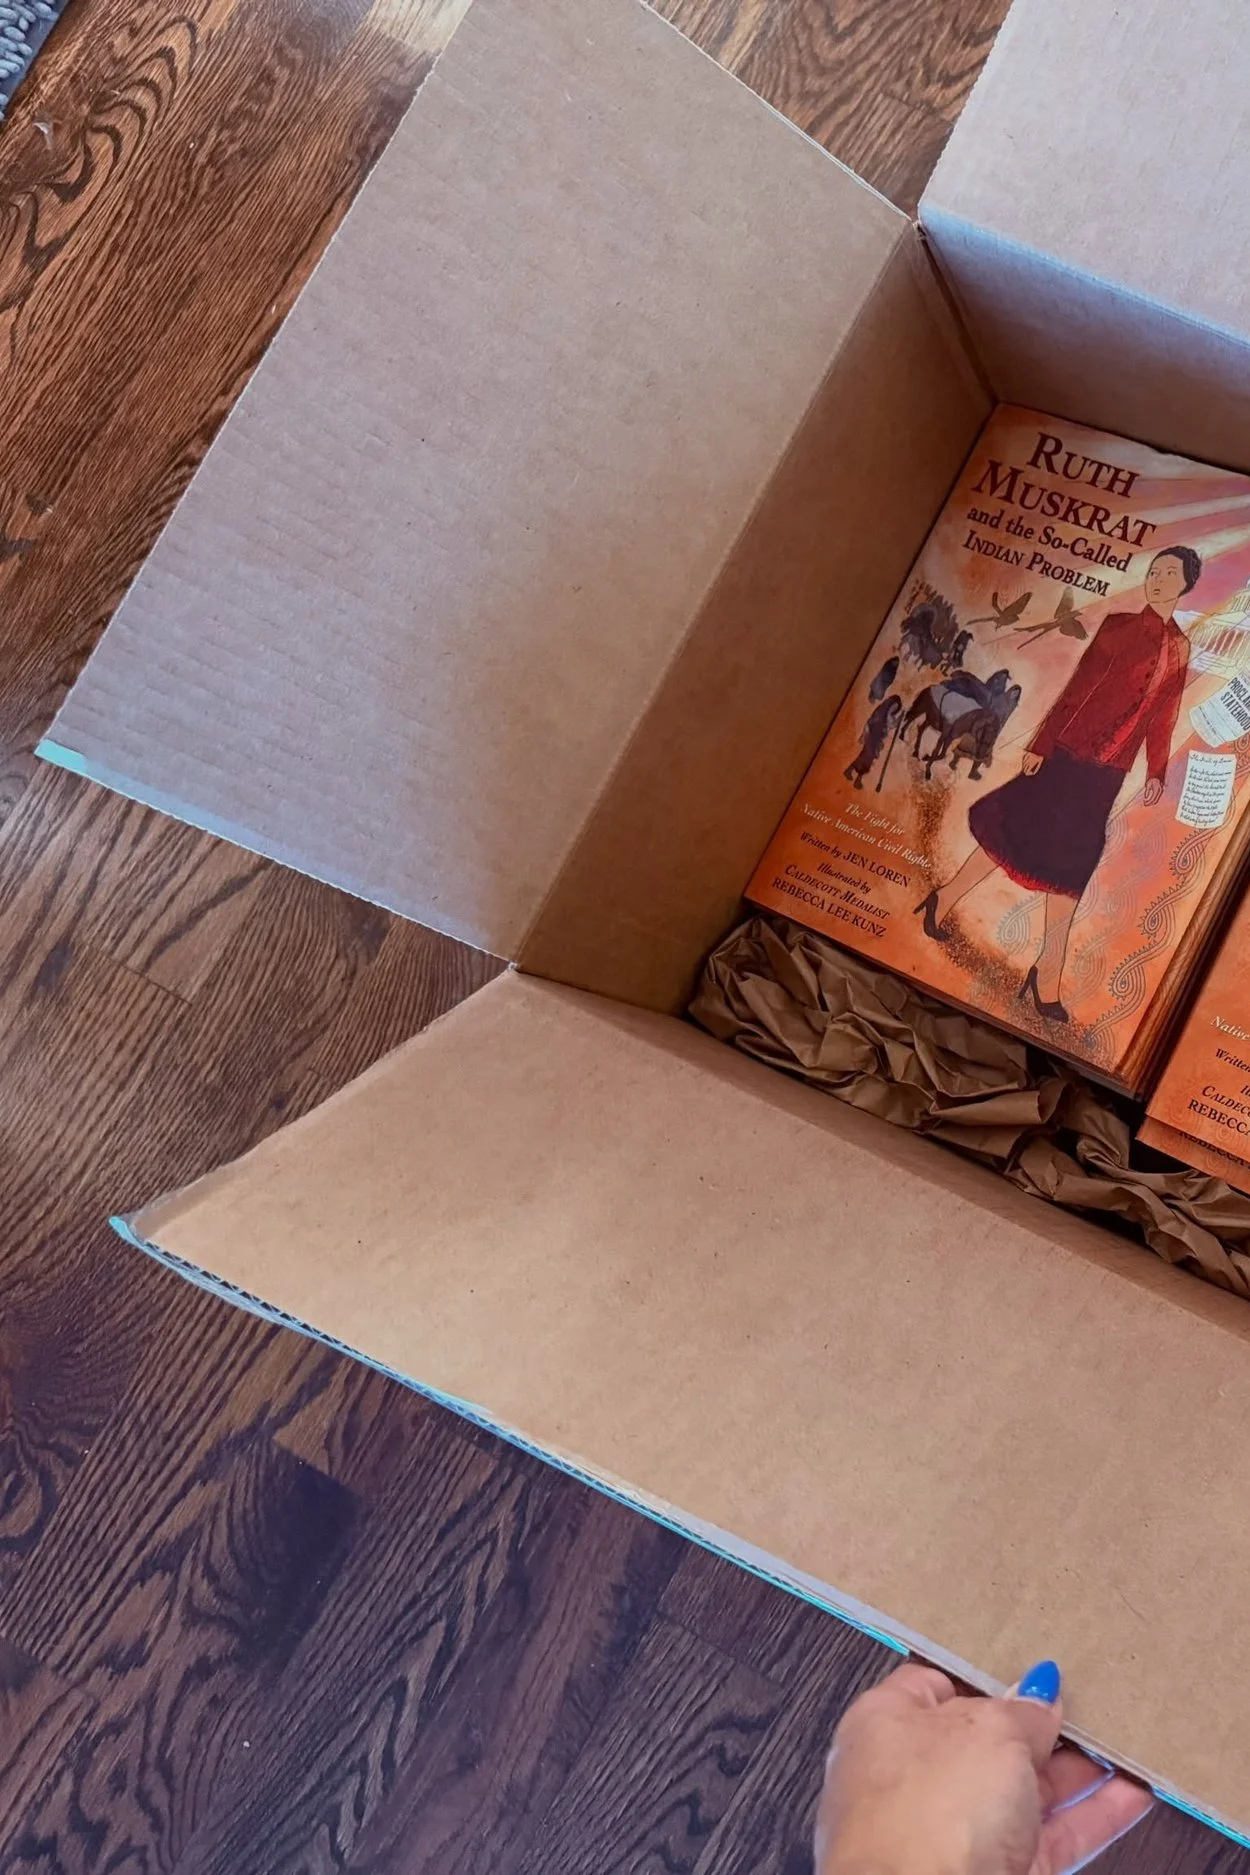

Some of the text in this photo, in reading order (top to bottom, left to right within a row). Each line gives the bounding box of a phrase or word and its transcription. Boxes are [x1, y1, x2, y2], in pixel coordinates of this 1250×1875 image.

[1027, 432, 1139, 498] RUTH
[971, 460, 1157, 547] MUSKRAT
[963, 531, 1111, 597] INDIAN PROBLEM
[967, 506, 1133, 573] and the So-Called
[801, 803, 832, 823] Native
[832, 819, 875, 844] American
[877, 838, 901, 855] Civil
[845, 803, 905, 836] The Fight for
[801, 832, 911, 888] Written by JEN LOREN
[817, 863, 872, 894] Illustrated by
[772, 877, 887, 938] REBECCA LEE KUNZ
[785, 864, 890, 920] CALDECOTT MEDALIST
[1211, 1016, 1250, 1040] Native
